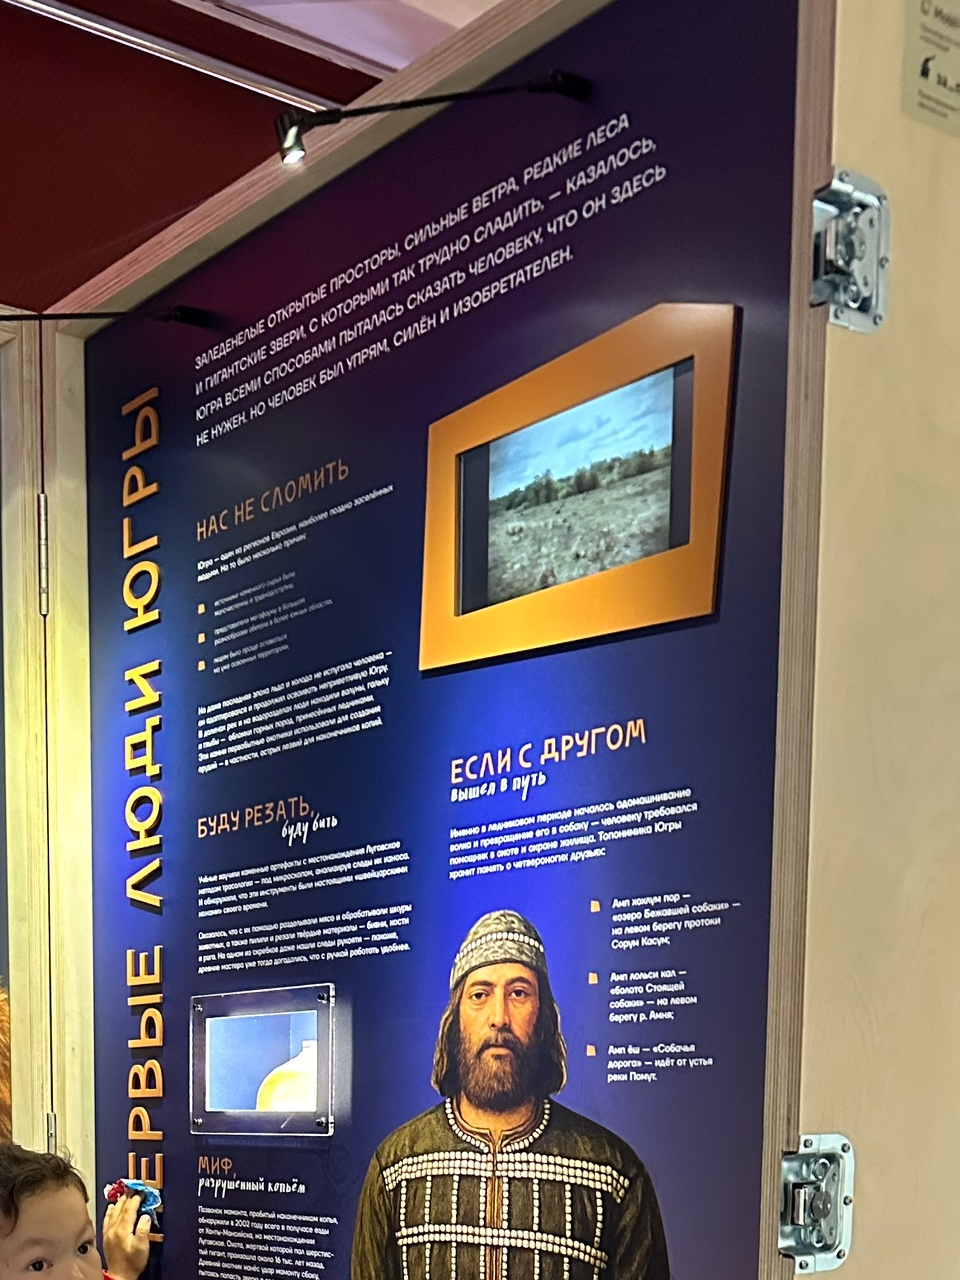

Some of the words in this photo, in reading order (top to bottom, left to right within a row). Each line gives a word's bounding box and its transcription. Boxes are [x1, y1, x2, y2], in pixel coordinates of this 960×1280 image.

[195, 319, 265, 369] ЗАЛЕДЕНЕЛЫЕ
[267, 283, 327, 328] ОТКРЫТЫЕ
[330, 242, 401, 293] ПРОСТОРЫ,
[404, 202, 468, 250] СИЛЬНЫЕ
[472, 176, 519, 213] ВЕТРА,
[524, 138, 581, 184] РЕДКИЕ
[586, 113, 629, 150] ЛЕСА
[196, 397, 223, 421] ЮГРА
[225, 376, 261, 405] ВСЕМИ
[263, 335, 336, 384] СПОСОБАМИ
[339, 302, 404, 346] ПЫТАЛАСЬ
[406, 270, 466, 309] СКАЗАТЬ
[468, 227, 543, 275] ЧЕЛОВЕКУ,
[547, 209, 578, 234] ЧТО
[582, 193, 605, 218] ОН
[611, 165, 666, 204] ЗДЕСЬ
[122, 386, 160, 631] ЮГРЫ
[197, 509, 228, 541] НАС
[234, 497, 254, 525] НЕ
[260, 459, 348, 512] СЛОМИТЬ
[125, 661, 163, 907] ЛЮДИ
[450, 781, 495, 802] вышел
[500, 777, 507, 792] в
[512, 771, 546, 799] путь
[451, 747, 511, 784] ЕСЛИ
[518, 742, 532, 768] С
[540, 718, 645, 765] ДРУГОМ
[198, 811, 239, 838] БУДУ
[281, 819, 309, 846] буду
[312, 813, 338, 831] бить
[126, 947, 164, 1242] ЕРВЫЕ
[197, 1177, 264, 1197] разрушенный
[267, 1178, 305, 1193] копьём
